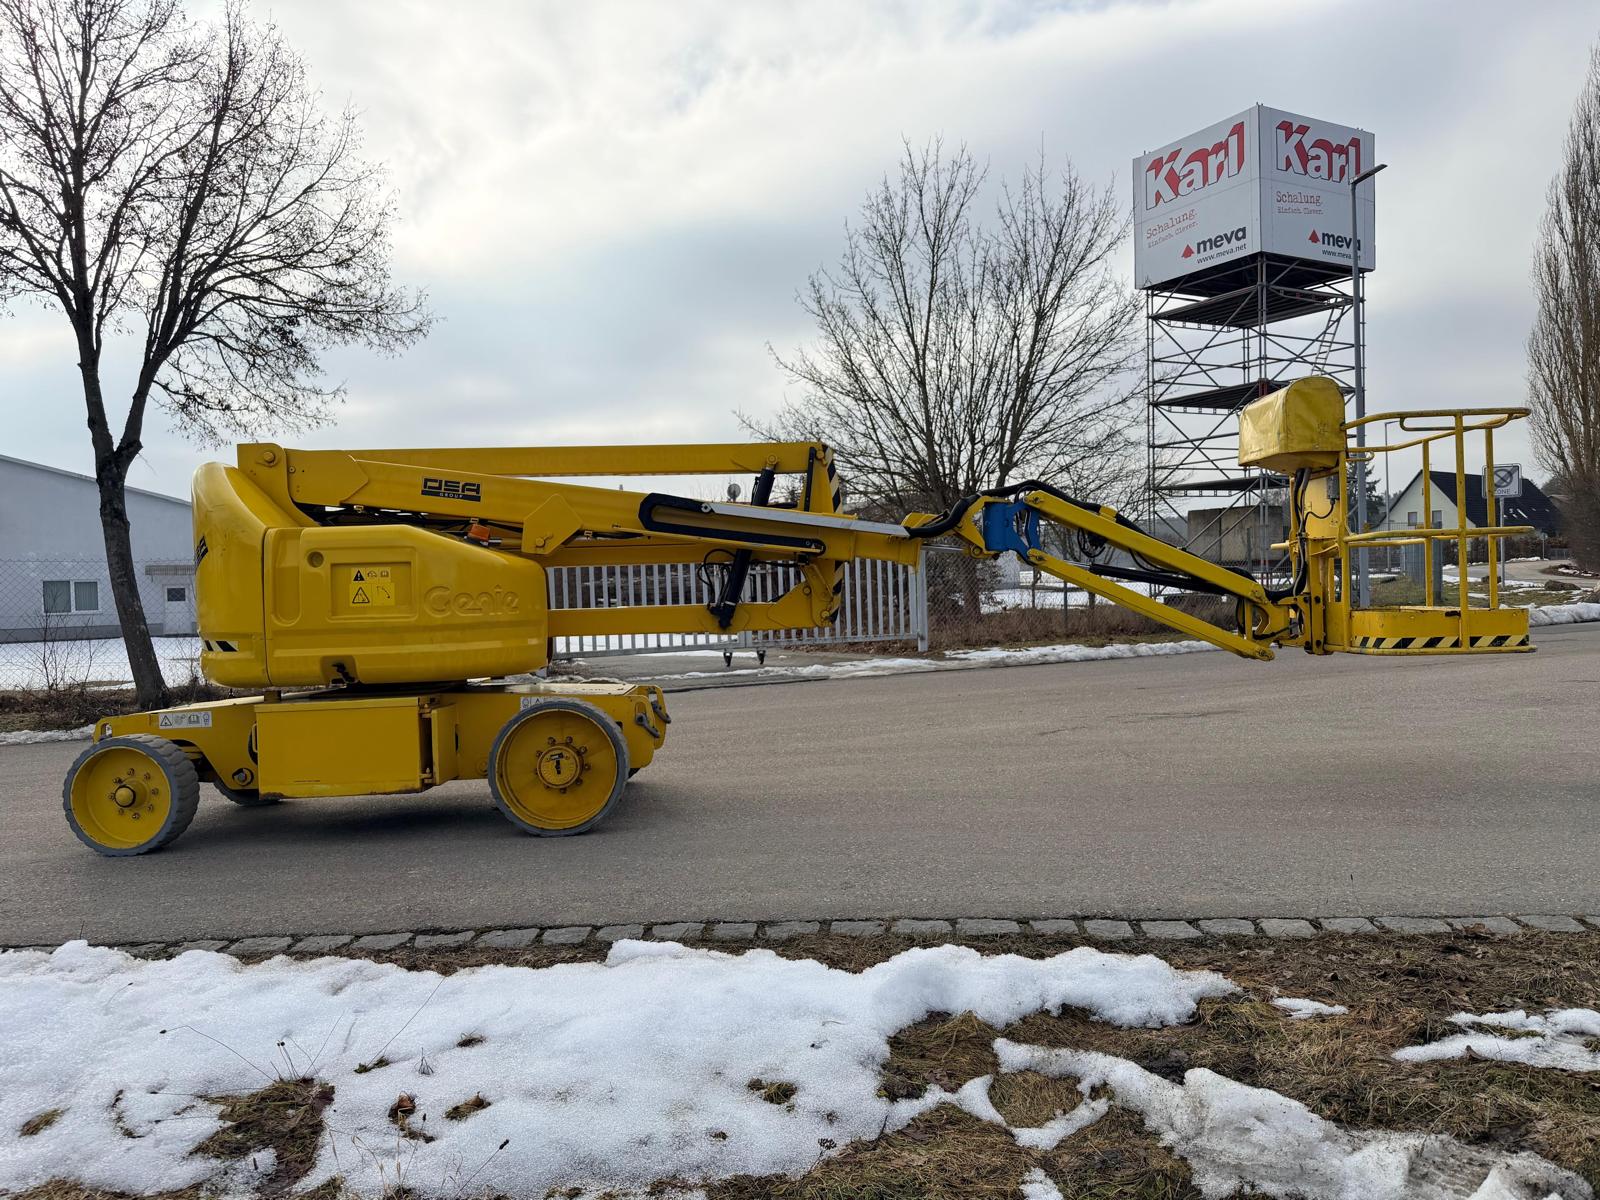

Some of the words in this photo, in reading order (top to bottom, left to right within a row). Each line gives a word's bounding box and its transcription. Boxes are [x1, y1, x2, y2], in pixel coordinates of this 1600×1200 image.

[1145, 121, 1245, 211] Karl
[1275, 120, 1361, 185] Karl
[1196, 226, 1247, 254] meva
[1196, 243, 1247, 264] www.meva.net
[424, 584, 519, 618] Genie
